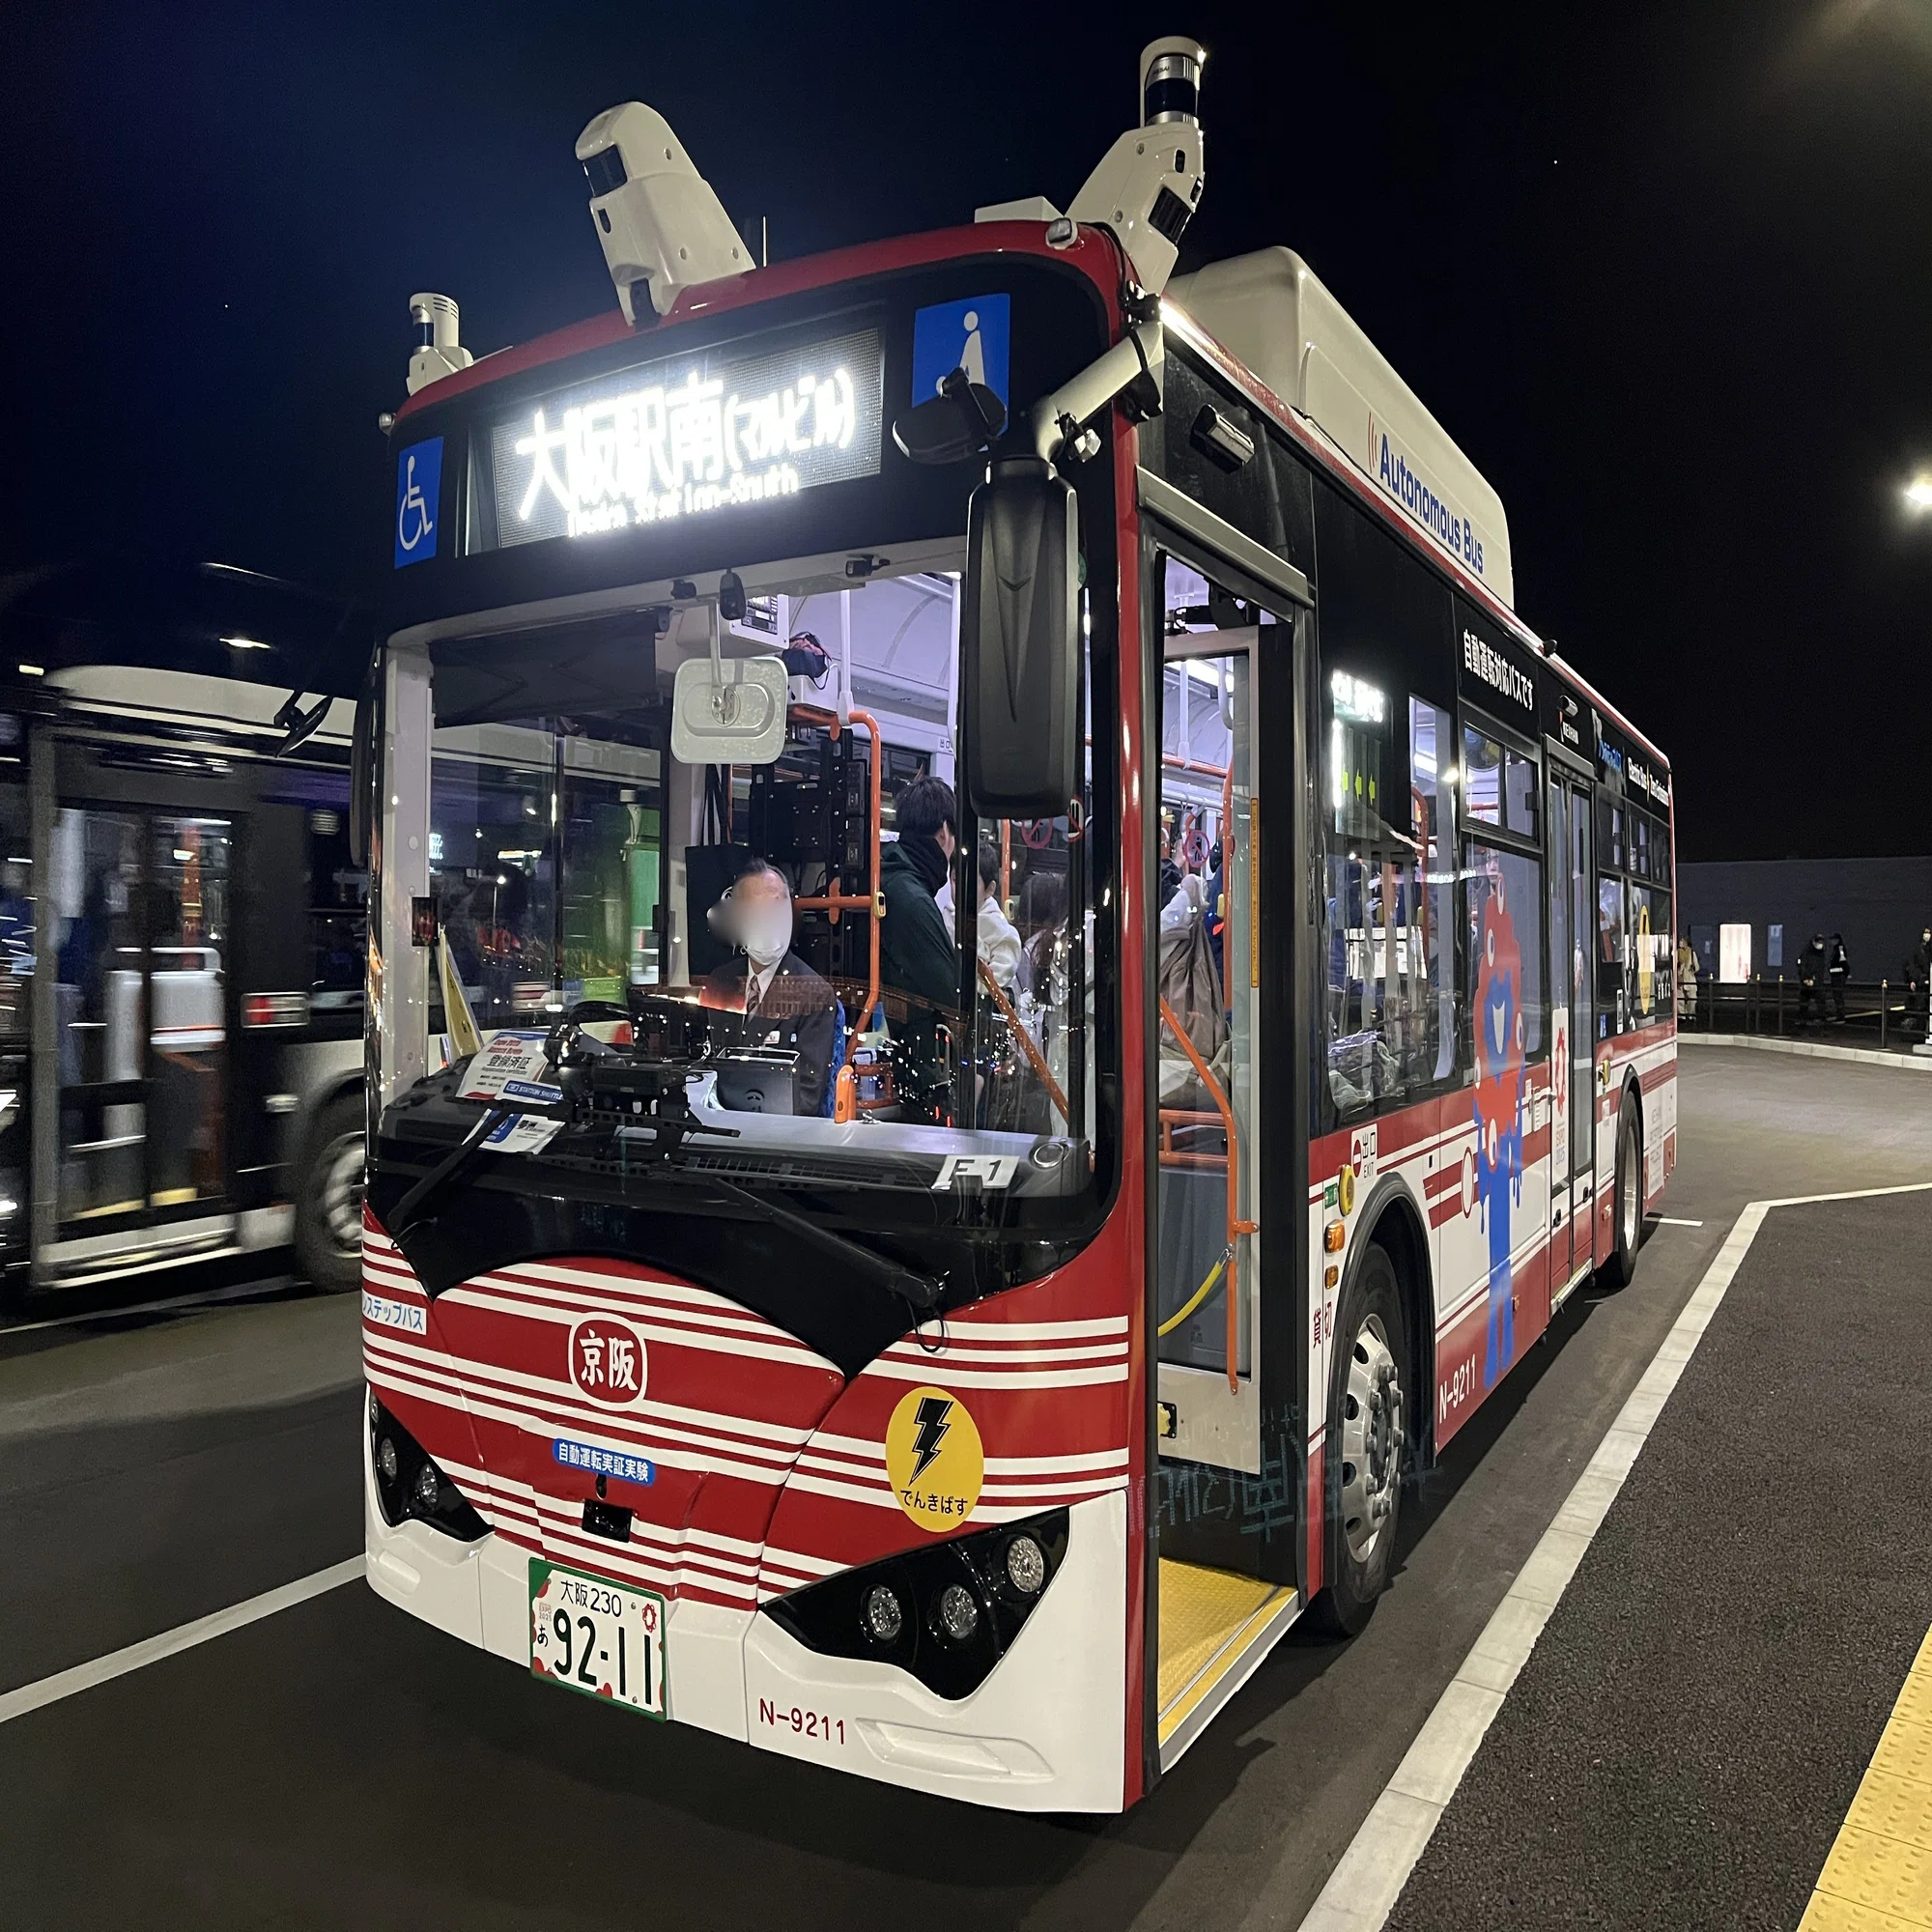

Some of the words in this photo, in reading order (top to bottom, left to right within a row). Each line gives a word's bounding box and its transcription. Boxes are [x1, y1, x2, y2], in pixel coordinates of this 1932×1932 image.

[1379, 433, 1462, 553] Autonomous
[1463, 517, 1485, 575] Bus
[1463, 629, 1533, 711] 自動運転対応バスです
[519, 1086, 541, 1095] STATION
[1362, 1131, 1376, 1158] 出口
[1363, 1162, 1375, 1178] EXIT
[580, 1328, 639, 1391] 京阪
[1439, 1353, 1476, 1424] N-9211
[558, 1442, 649, 1483] 自動運転実証実験
[899, 1488, 968, 1518] でんきばす
[554, 1607, 652, 1706] 92-11
[758, 1697, 846, 1746] N-9211
